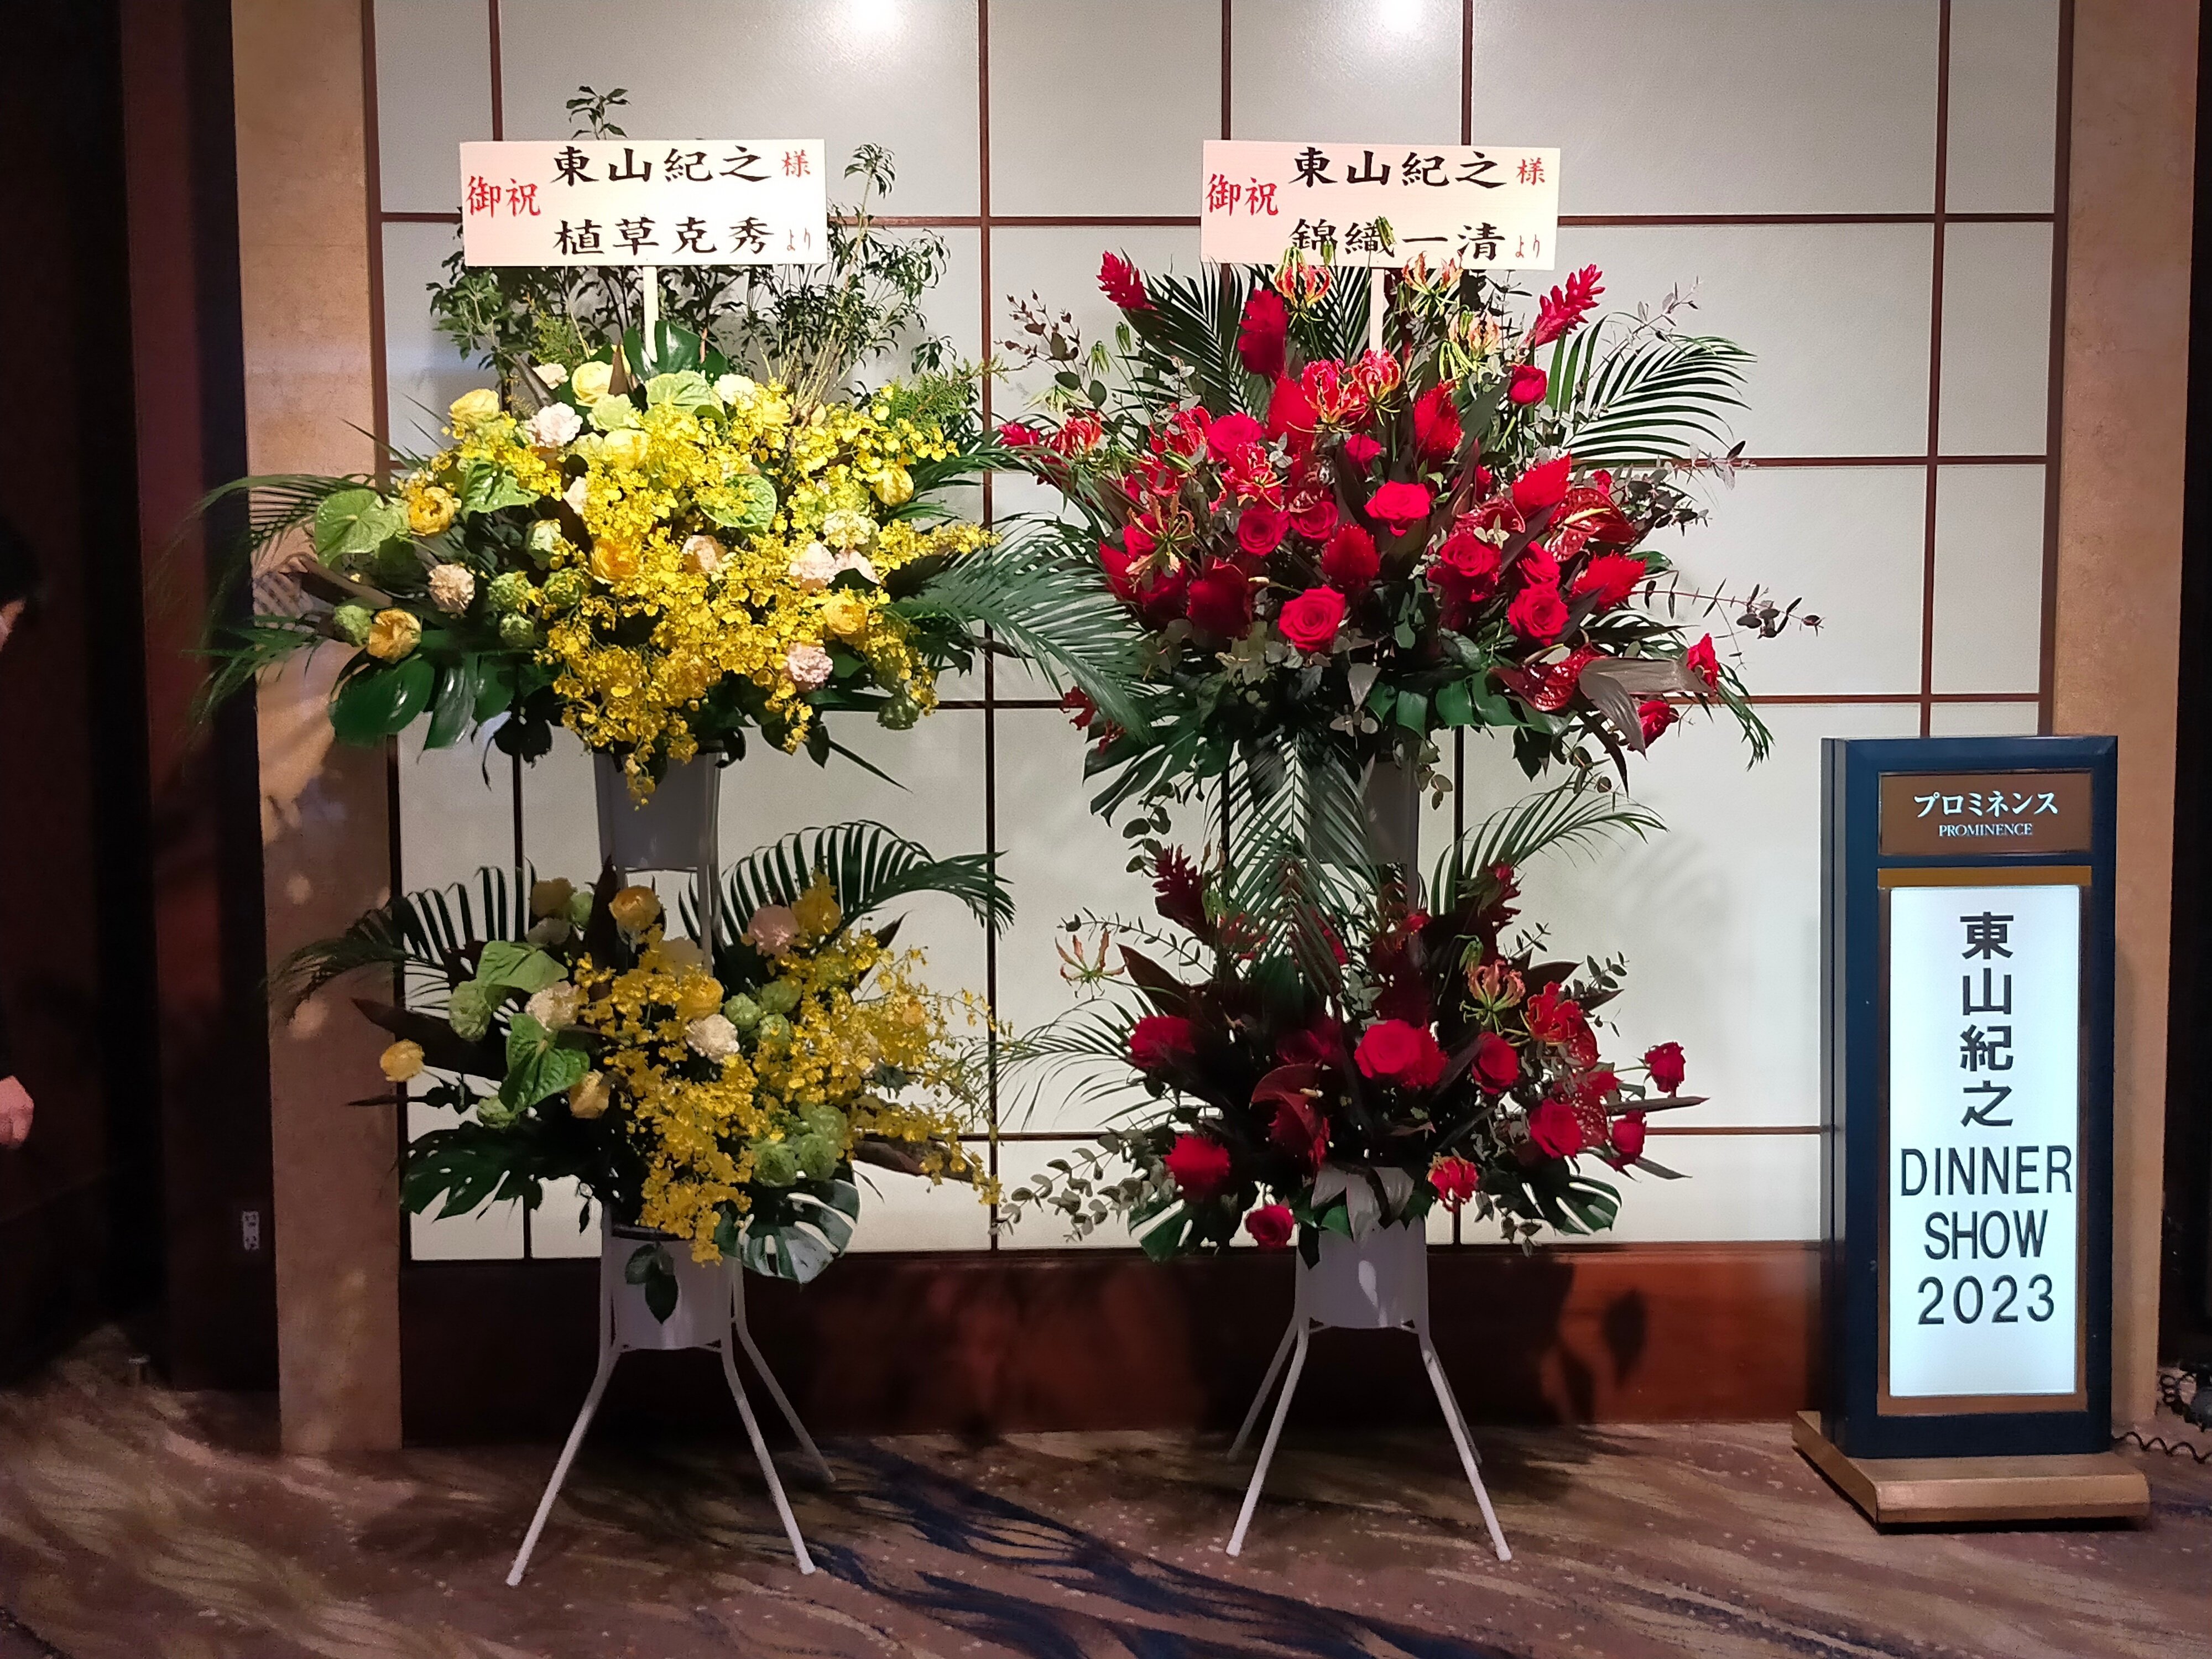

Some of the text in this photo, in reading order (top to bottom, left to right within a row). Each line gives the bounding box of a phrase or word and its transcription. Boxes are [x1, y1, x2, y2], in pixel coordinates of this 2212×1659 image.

[466, 175, 541, 218] 御祝
[1205, 173, 1279, 216] 御祝
[1913, 790, 2059, 818] プロミネンス
[1938, 822, 2033, 837] PROMINENCE
[1959, 911, 2014, 1128] 東山紀之
[1900, 1145, 2072, 1197] DINNER
[1923, 1209, 2048, 1260] SHOW
[1917, 1274, 2055, 1326] 2023
